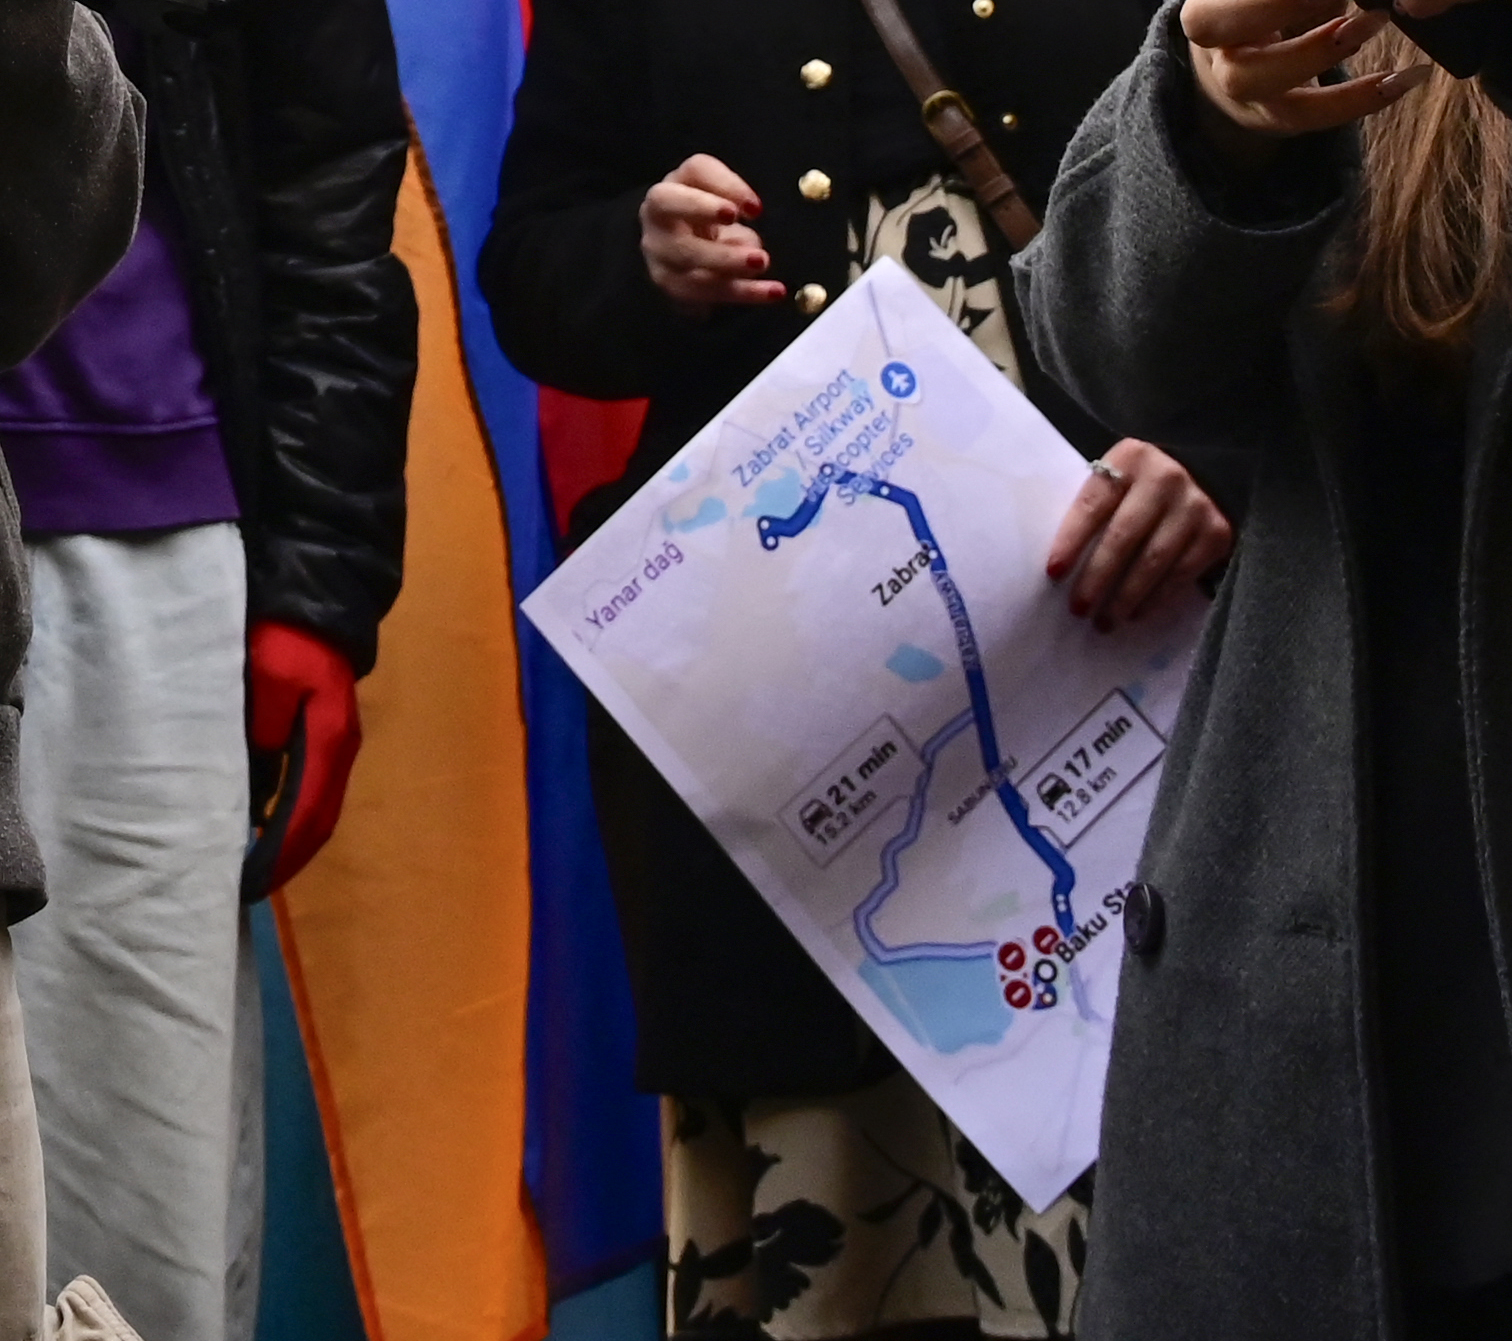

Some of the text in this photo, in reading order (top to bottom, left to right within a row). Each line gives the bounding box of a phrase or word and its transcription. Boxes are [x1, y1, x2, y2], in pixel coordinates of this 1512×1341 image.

[731, 369, 855, 487] Zabrat Airport
[804, 390, 876, 456] Silkway
[585, 577, 643, 630] Yanar
[827, 740, 899, 806] 21 min
[1063, 711, 1134, 779] 17 min
[849, 790, 879, 815] km
[1056, 766, 1118, 823] 12.8 km
[1053, 911, 1108, 965] Baku
